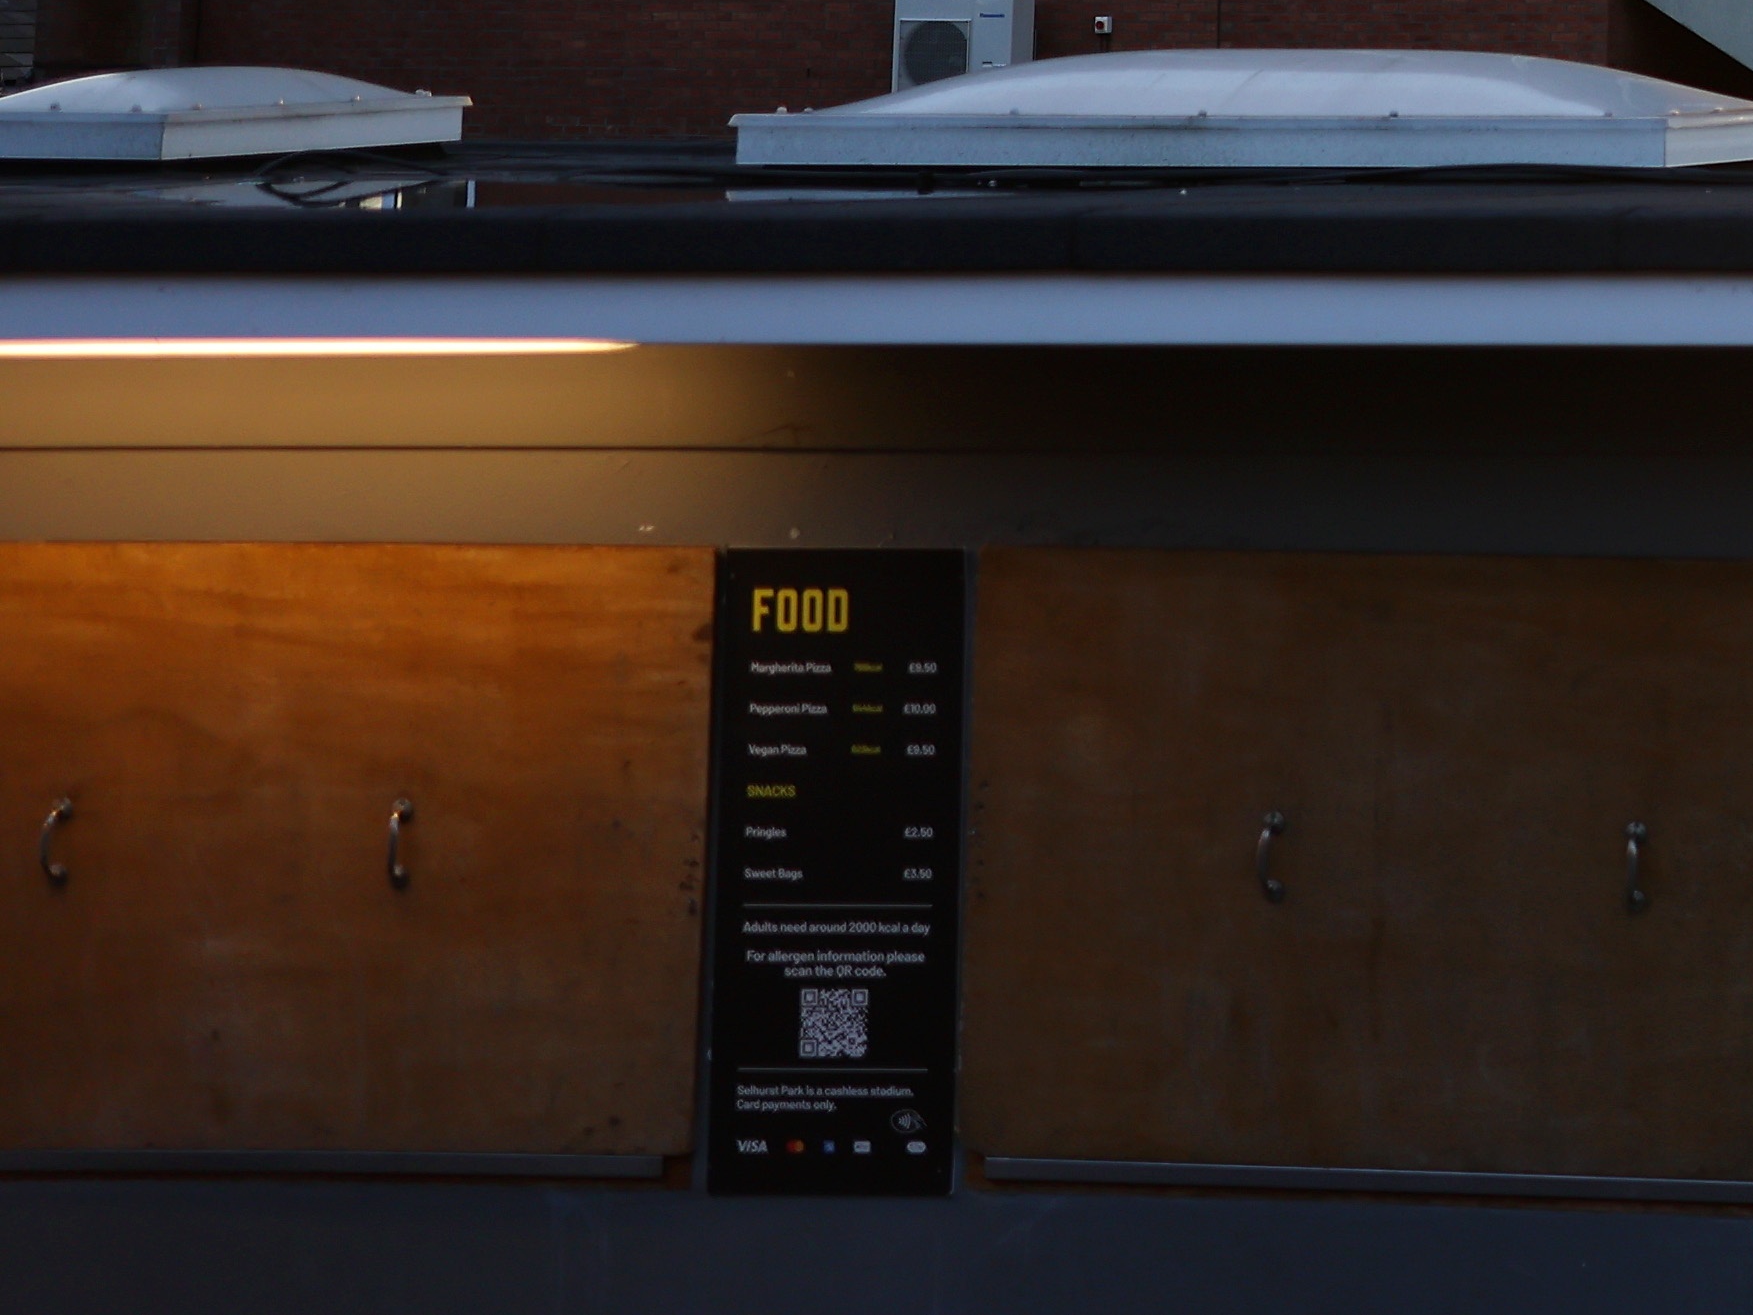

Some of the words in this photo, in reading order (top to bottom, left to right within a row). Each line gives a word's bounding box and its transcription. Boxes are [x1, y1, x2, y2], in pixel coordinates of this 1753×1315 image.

[752, 588, 848, 632] FOOD
[750, 661, 805, 675] Margherita
[805, 662, 832, 673] Pizza
[908, 662, 937, 673] £9.50
[749, 702, 800, 716] Pepperoni
[801, 703, 827, 714] Pizza
[903, 703, 936, 714] £10.00
[748, 744, 780, 757] Vegan
[780, 744, 807, 755] Pizza
[906, 744, 935, 755] £9.50
[747, 784, 796, 797] SNACKS
[745, 826, 787, 840] Pringles
[904, 826, 933, 838] £2.50
[744, 868, 776, 879] Sweet
[777, 868, 803, 881] Bags
[903, 868, 932, 879] £3.50
[742, 921, 778, 933] Adults
[779, 921, 807, 933] need
[808, 921, 847, 933] around
[848, 921, 878, 933] 2000
[877, 921, 901, 933] kcal
[910, 922, 930, 936] day
[746, 949, 766, 962] For
[767, 950, 815, 965] allergen
[816, 949, 885, 963] information
[886, 950, 925, 964] please
[784, 967, 813, 977] scan
[814, 965, 834, 977] the
[836, 965, 853, 978] QR
[854, 965, 886, 977] code.
[737, 1085, 779, 1096] Selhurst
[780, 1085, 804, 1096] Park
[824, 1085, 869, 1096] cashless
[870, 1086, 913, 1097] stadium.
[736, 1099, 760, 1110] Card
[761, 1099, 812, 1112] payments
[813, 1099, 836, 1112] only.
[737, 1140, 767, 1153] VISA
